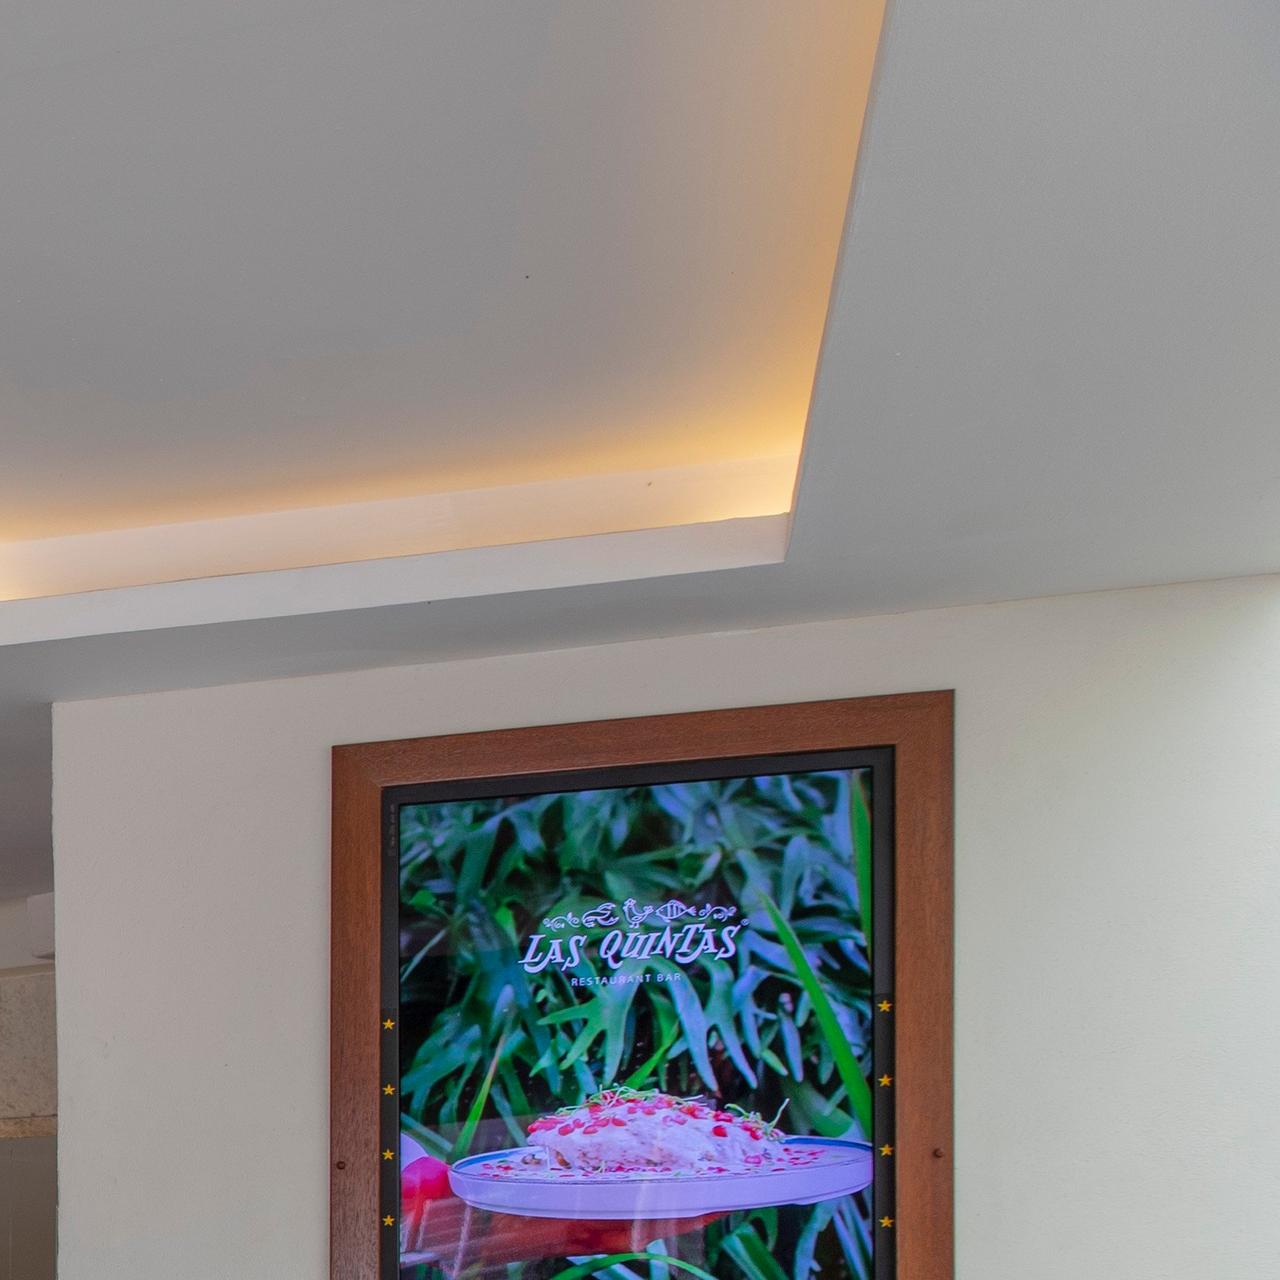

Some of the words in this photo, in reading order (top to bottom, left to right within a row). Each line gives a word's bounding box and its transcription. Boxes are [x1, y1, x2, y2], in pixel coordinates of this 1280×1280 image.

[518, 934, 587, 974] LAS
[600, 923, 741, 969] QUINTAS
[571, 975, 651, 987] RESTAURANT
[657, 973, 681, 983] BAR
